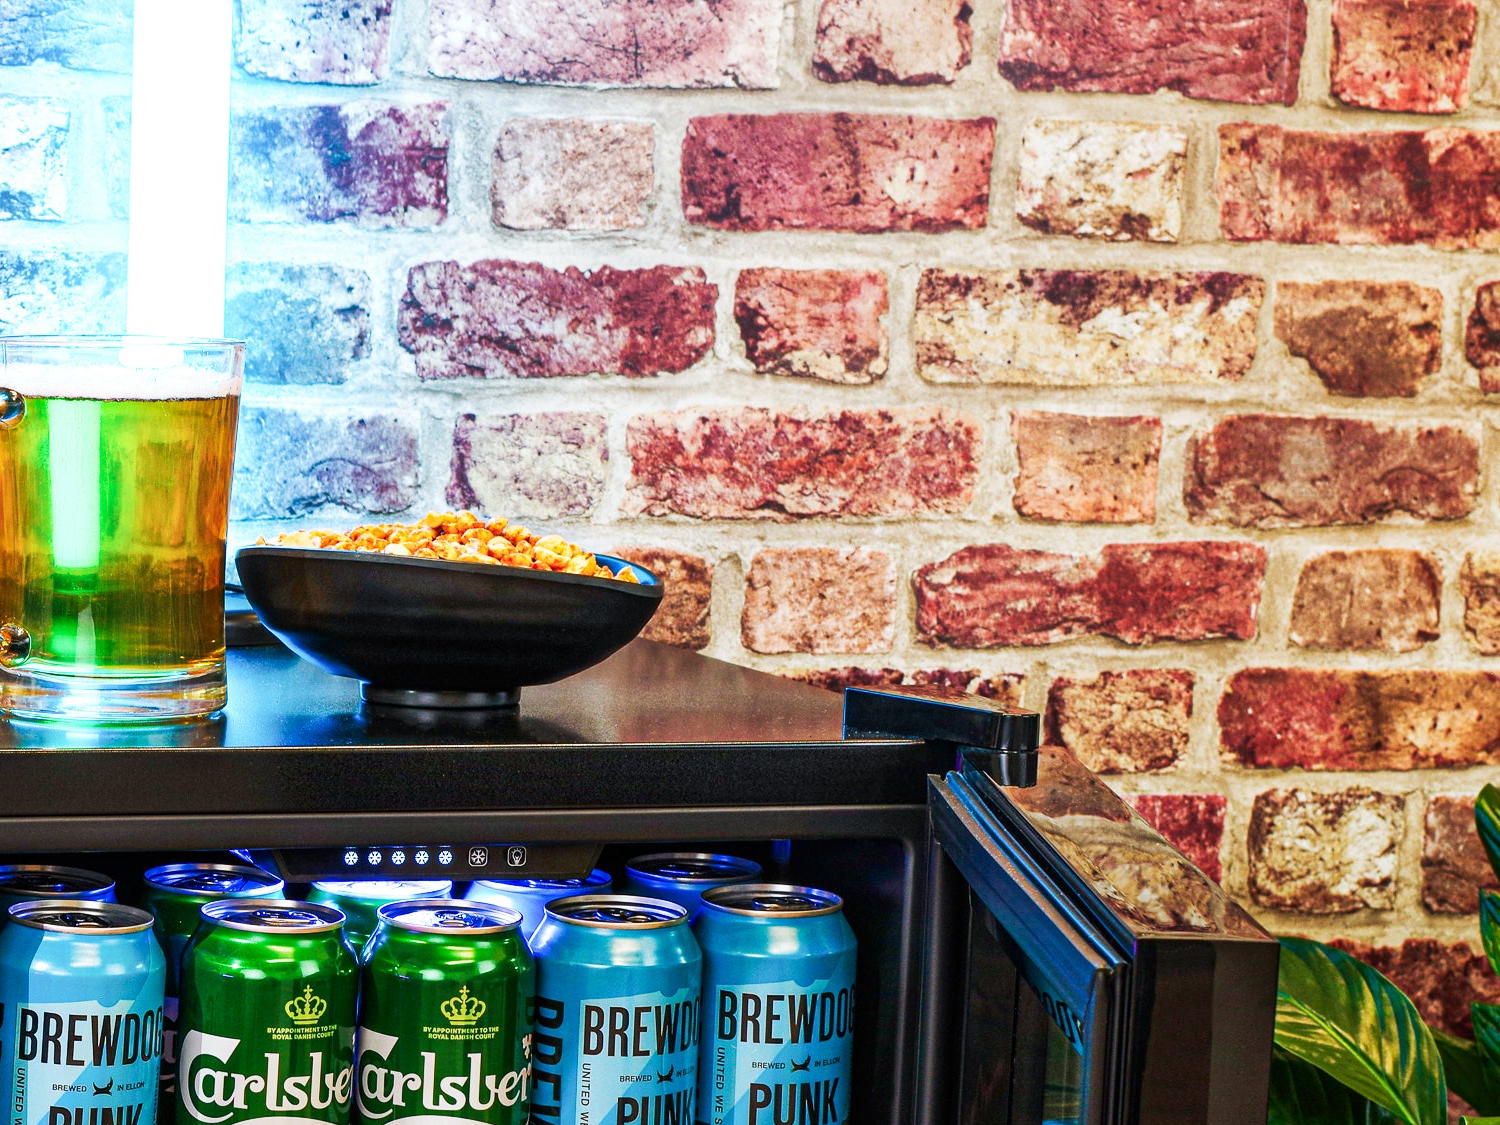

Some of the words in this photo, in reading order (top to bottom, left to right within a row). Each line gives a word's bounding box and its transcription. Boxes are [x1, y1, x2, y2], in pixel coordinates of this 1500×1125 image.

[583, 996, 700, 1057] BREWDO
[179, 1029, 353, 1123] Carlsbe
[356, 1026, 532, 1119] Carlsber
[580, 1062, 591, 1106] UNITED
[619, 1074, 652, 1083] BREWED
[716, 1047, 725, 1090] UNITED
[751, 1061, 786, 1070] BREWED
[814, 1060, 821, 1068] IN
[822, 1057, 841, 1066] ELLON
[14, 1067, 26, 1113] UNITED
[52, 1083, 87, 1092] BREWED
[117, 1083, 124, 1091] IN
[125, 1081, 145, 1090] ELLON
[715, 1094, 723, 1113] WE
